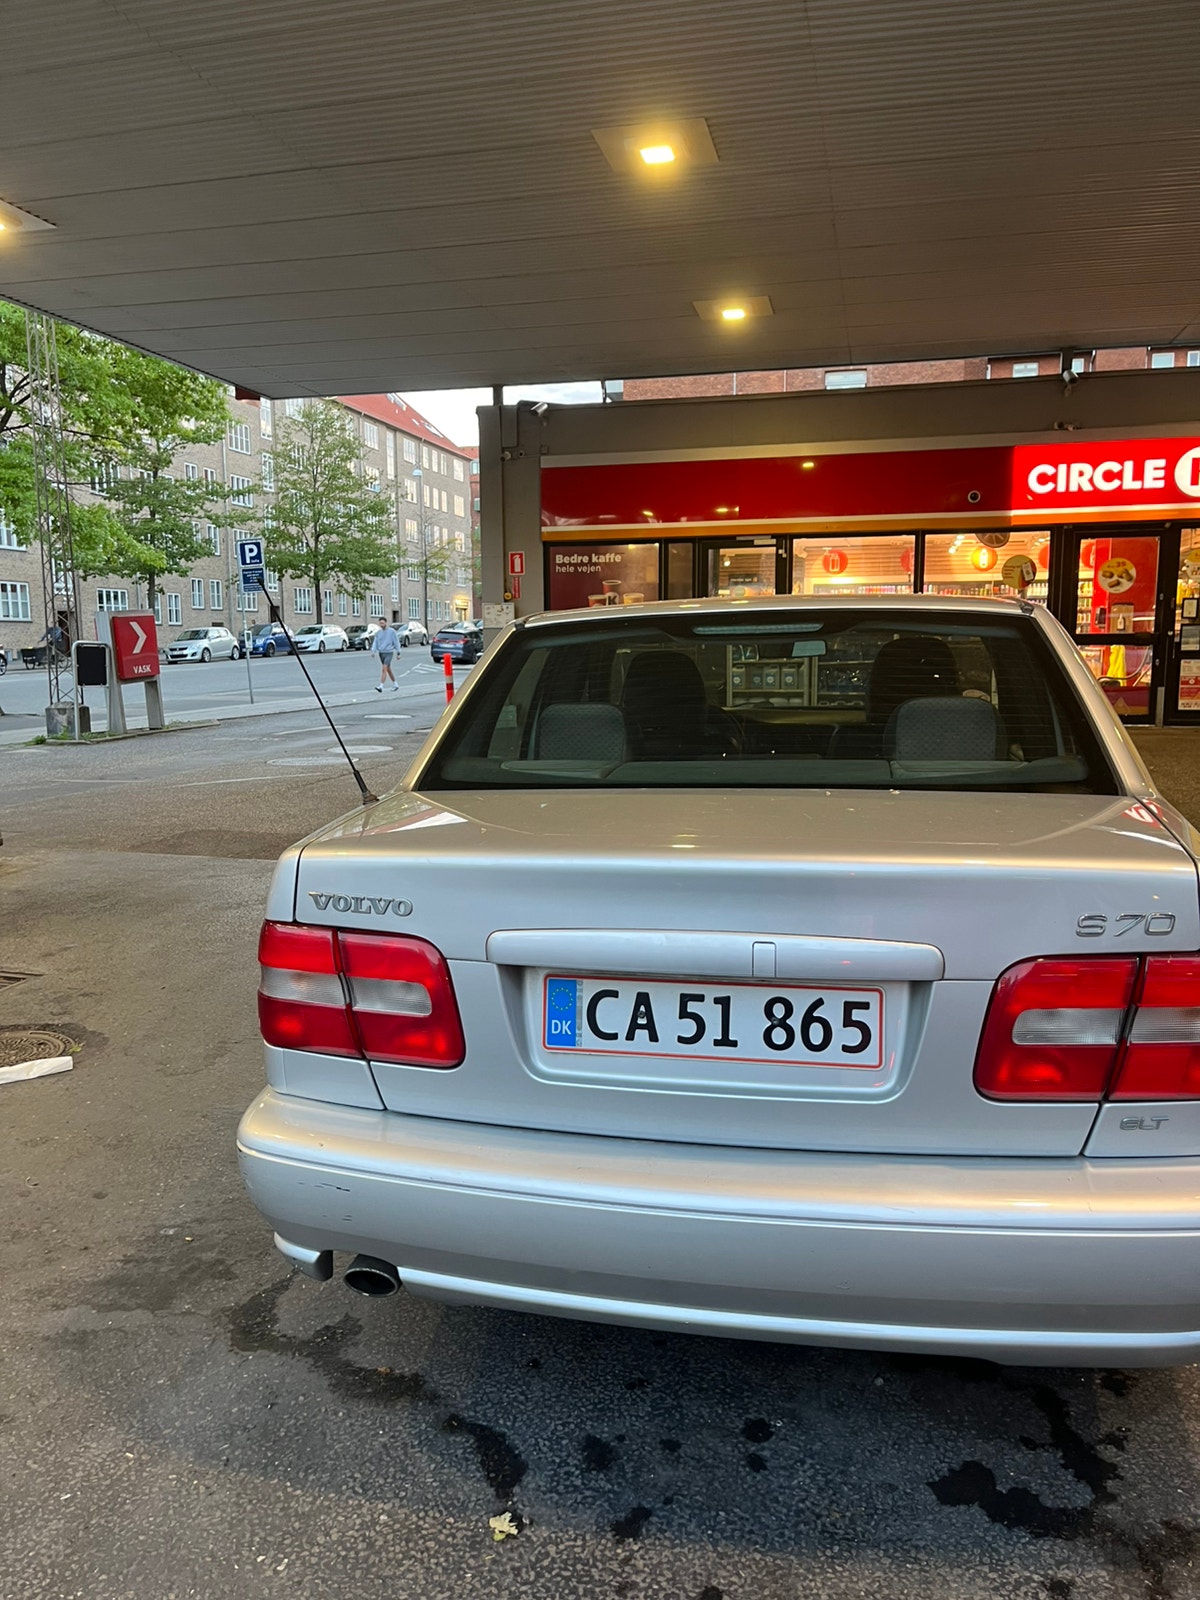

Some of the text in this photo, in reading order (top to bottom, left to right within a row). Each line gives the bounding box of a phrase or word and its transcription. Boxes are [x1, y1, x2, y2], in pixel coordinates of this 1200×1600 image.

[1028, 458, 1166, 494] CIRCLE
[244, 544, 258, 563] P
[555, 552, 622, 564] Bedre kaffe
[556, 564, 602, 574] hele vejen
[133, 664, 151, 674] VASK
[308, 891, 413, 917] VOLVO
[1076, 913, 1175, 937] S70
[551, 1019, 572, 1035] DK
[586, 989, 659, 1042] CA
[677, 992, 738, 1048] 51
[763, 996, 872, 1054] 865
[1119, 1116, 1169, 1131] GLT
